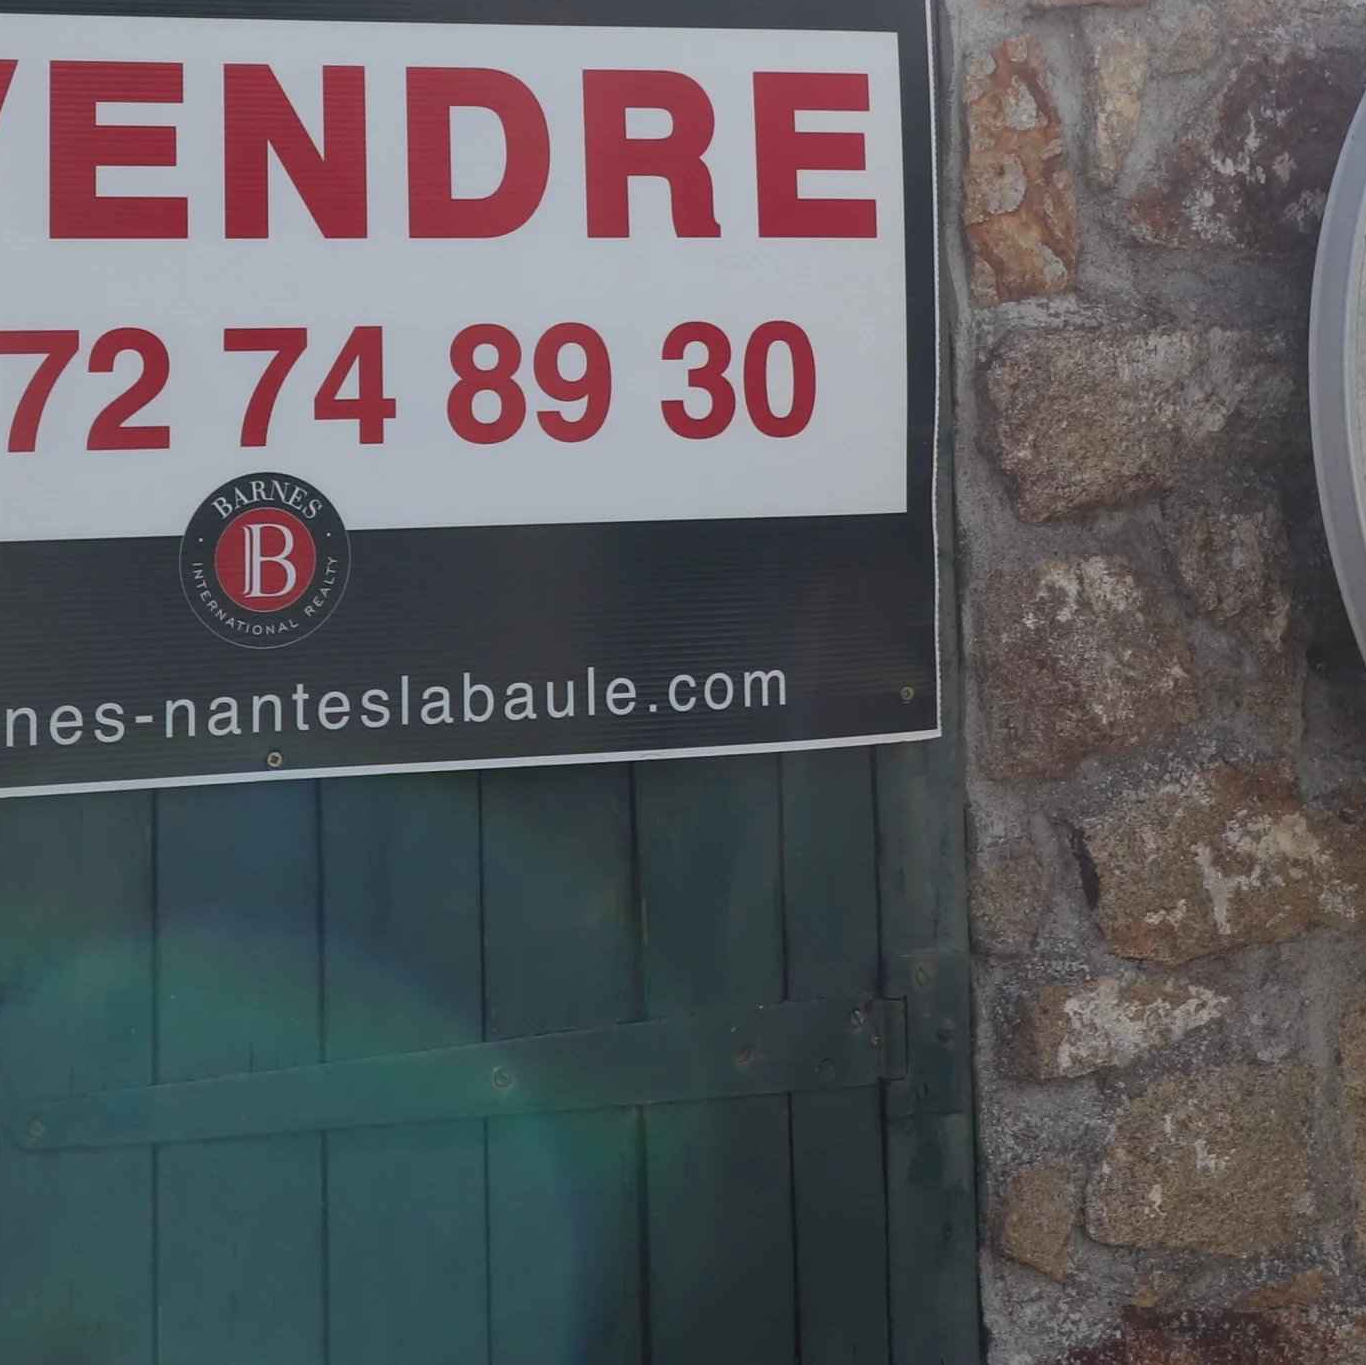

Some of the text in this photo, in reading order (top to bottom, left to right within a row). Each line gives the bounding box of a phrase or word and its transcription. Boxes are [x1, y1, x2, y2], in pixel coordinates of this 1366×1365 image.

[222, 325, 397, 447] 74
[445, 322, 614, 445] 89
[660, 319, 817, 441] 30
[211, 480, 323, 520] BARNES
[191, 556, 339, 635] INTERNATIONAL REALTY
